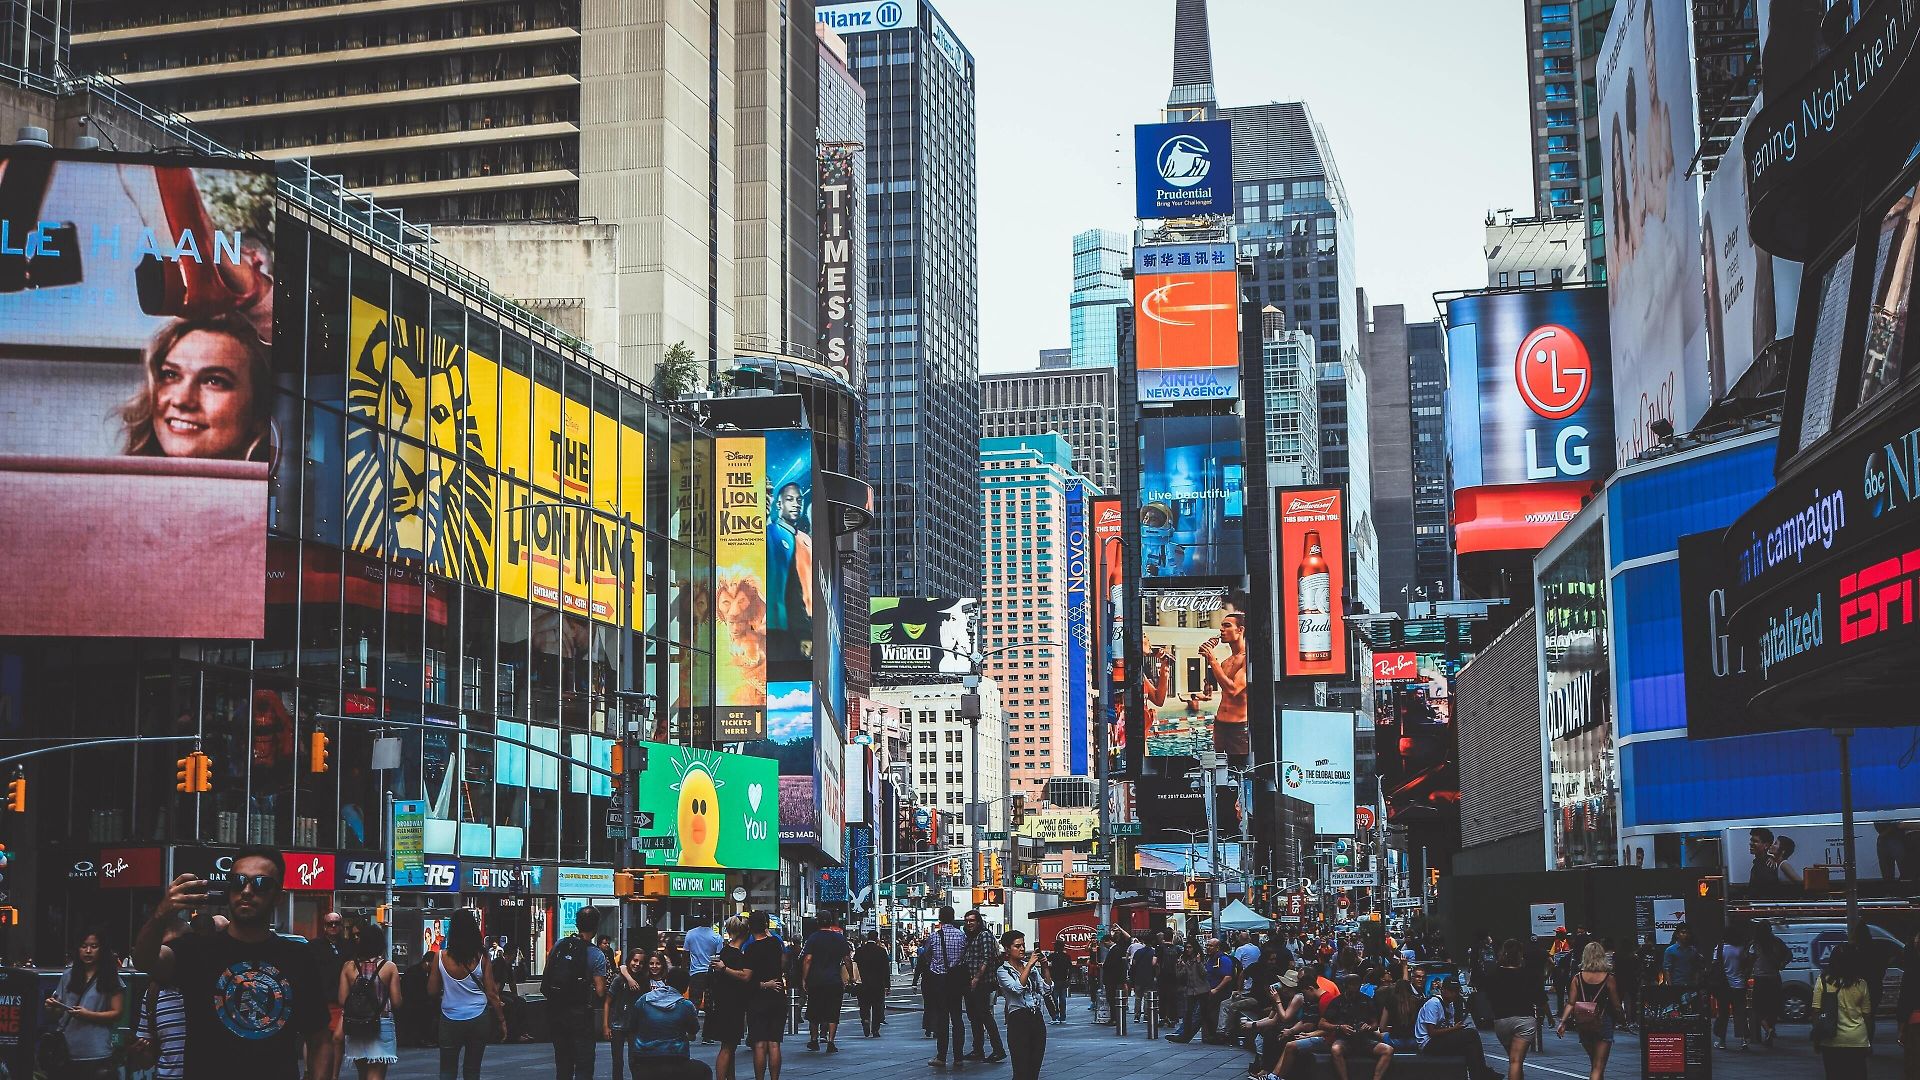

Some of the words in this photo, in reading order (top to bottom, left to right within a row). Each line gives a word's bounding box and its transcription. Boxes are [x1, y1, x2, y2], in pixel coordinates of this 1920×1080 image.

[1802, 67, 1853, 138] Night
[1854, 37, 1884, 93] Live
[1885, 14, 1898, 54] in
[1156, 188, 1212, 200] Prudential
[92, 223, 242, 265] HAAN
[824, 184, 848, 320] TIMES
[1143, 251, 1226, 268] 新华通讯社
[1159, 373, 1219, 387] XINHUA
[1146, 388, 1181, 398] NEWS
[1183, 385, 1232, 397] AGENCY
[550, 430, 590, 484] THE
[724, 450, 754, 463] Disney
[1525, 425, 1591, 481] LG
[726, 472, 752, 485] THE
[1864, 469, 1885, 500] abc
[722, 487, 758, 509] LION
[1149, 490, 1172, 500] Live
[1175, 488, 1230, 500] beautiful
[508, 467, 571, 566] LION
[1293, 502, 1330, 511] Budweiser
[720, 510, 763, 536] KING
[1752, 531, 1764, 579] in
[1767, 487, 1845, 564] campaign
[533, 585, 559, 600] ENTRANCE
[564, 594, 573, 605] ON
[574, 598, 587, 609] 45TH
[592, 602, 607, 615] STREET
[1375, 655, 1414, 675] Ray-Ban
[1547, 689, 1565, 740] OLD
[1565, 669, 1592, 735] NAVY
[1306, 770, 1314, 778] THE
[1315, 770, 1334, 779] GLOBAL
[1335, 771, 1350, 779] GOALS
[743, 812, 767, 841] YOU
[1038, 818, 1057, 826] WHAT
[1121, 824, 1132, 833] 44
[644, 839, 651, 848] W
[655, 838, 664, 847] 44
[102, 858, 129, 878] Ray-Ban
[298, 858, 325, 886] Ray-Ban
[492, 868, 532, 888] TISST
[672, 878, 687, 891] NEW
[688, 879, 704, 891] YORK
[710, 882, 724, 891] LINE
[1291, 894, 1301, 914] tkts
